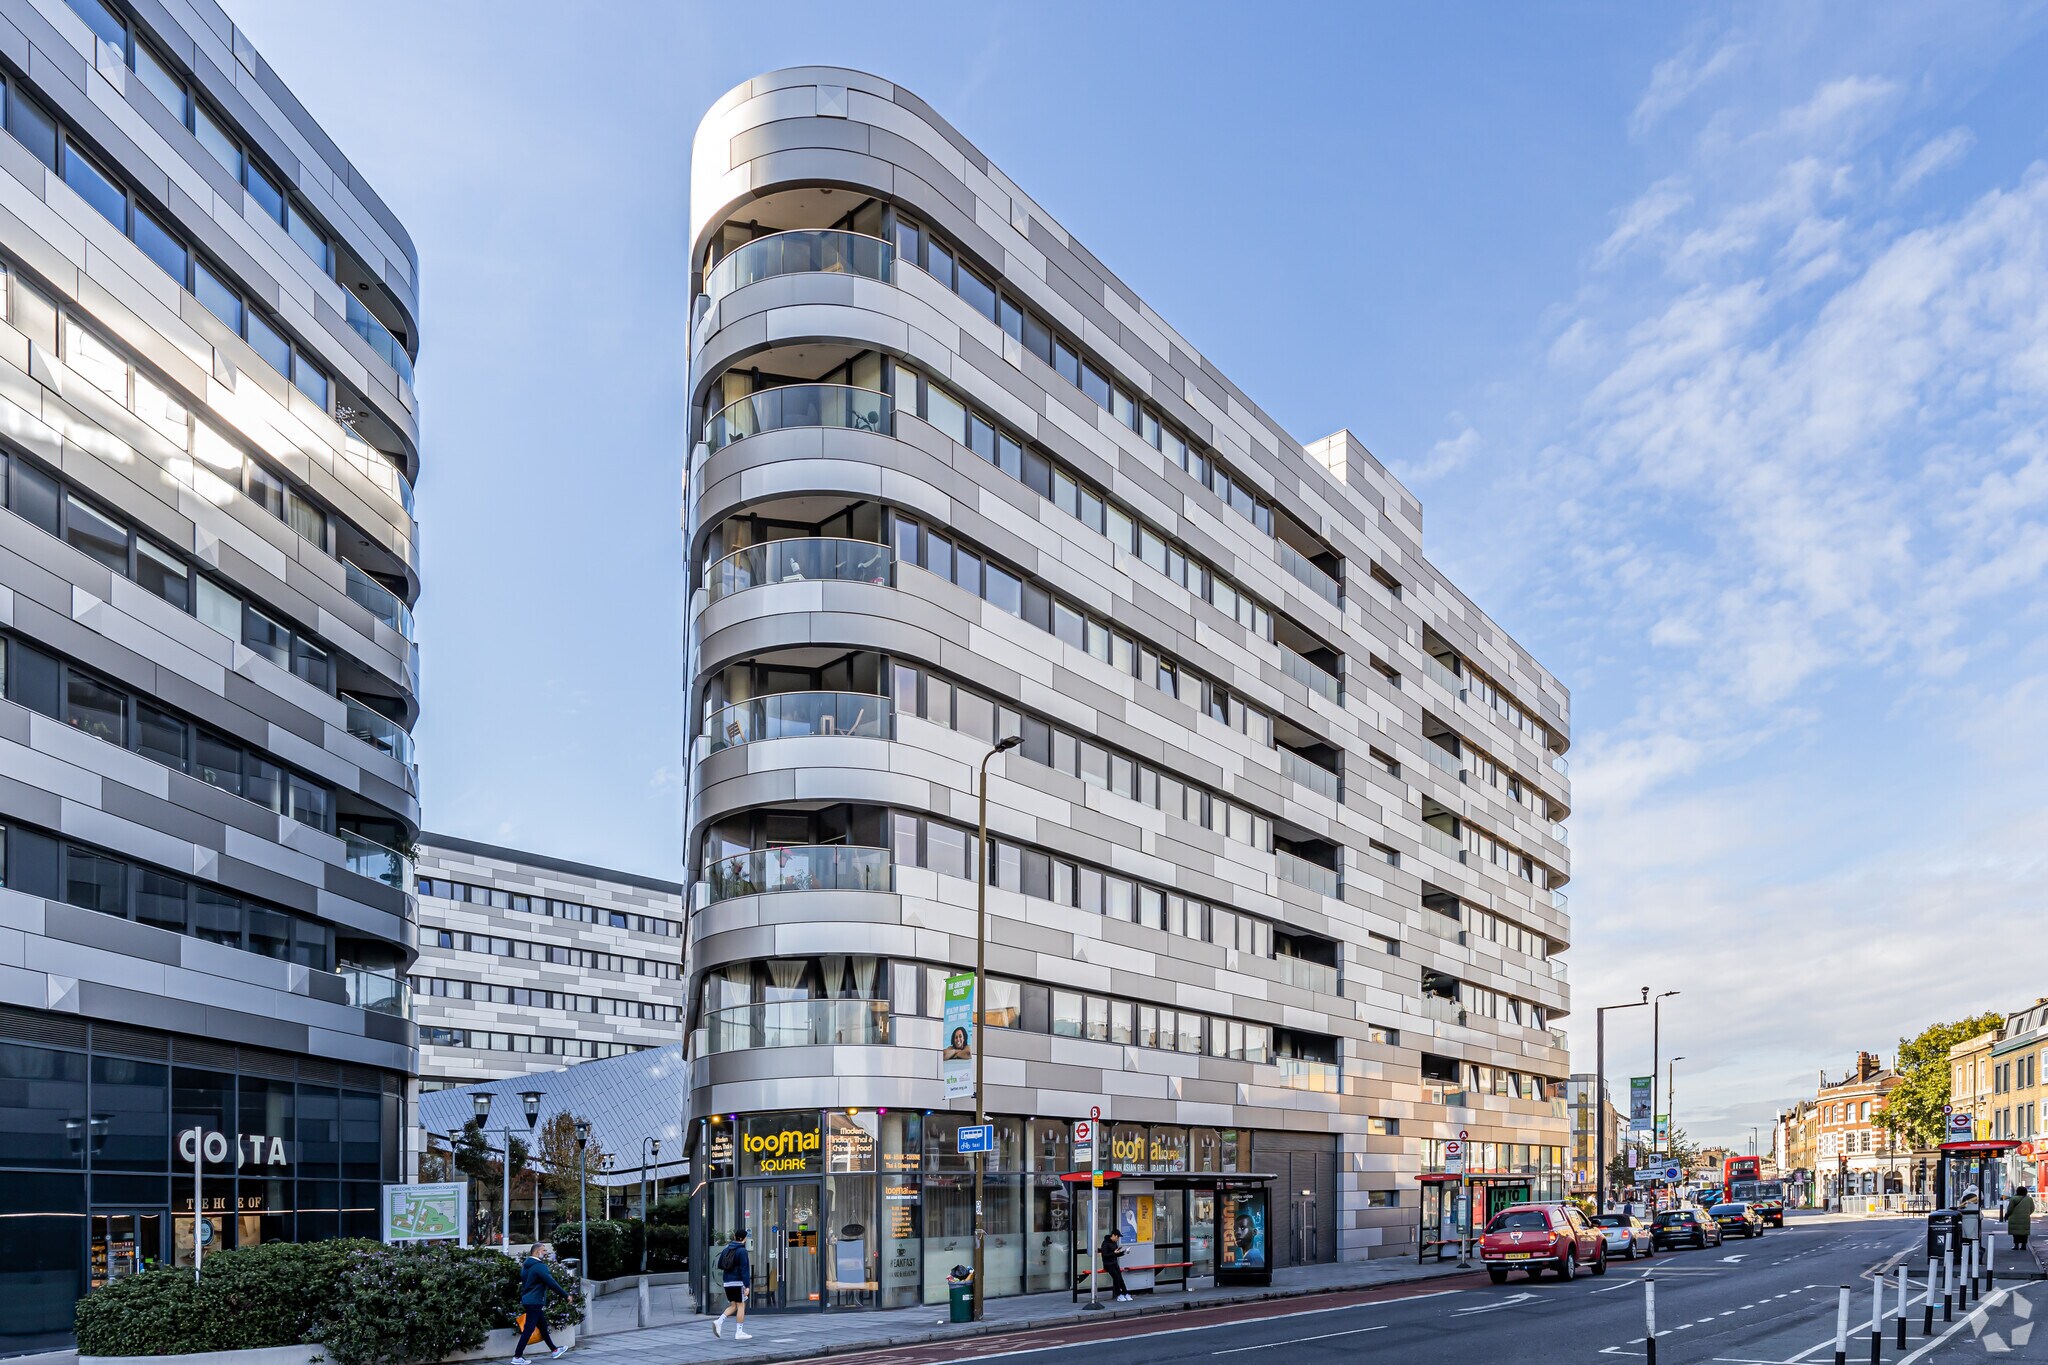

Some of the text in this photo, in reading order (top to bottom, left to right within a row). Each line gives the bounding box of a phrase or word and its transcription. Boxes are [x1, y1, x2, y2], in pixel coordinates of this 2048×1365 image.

[1092, 1107, 1098, 1118] B
[853, 1135, 868, 1143] Thai
[857, 1144, 873, 1152] Food
[760, 1158, 806, 1171] SQUARE
[1113, 1163, 1123, 1171] PAN
[1123, 1163, 1137, 1172] ASIAN
[186, 1196, 262, 1209] TE HOE OF
[1223, 1194, 1235, 1263] JUNGLE
[887, 1258, 917, 1268] REAKFAST
